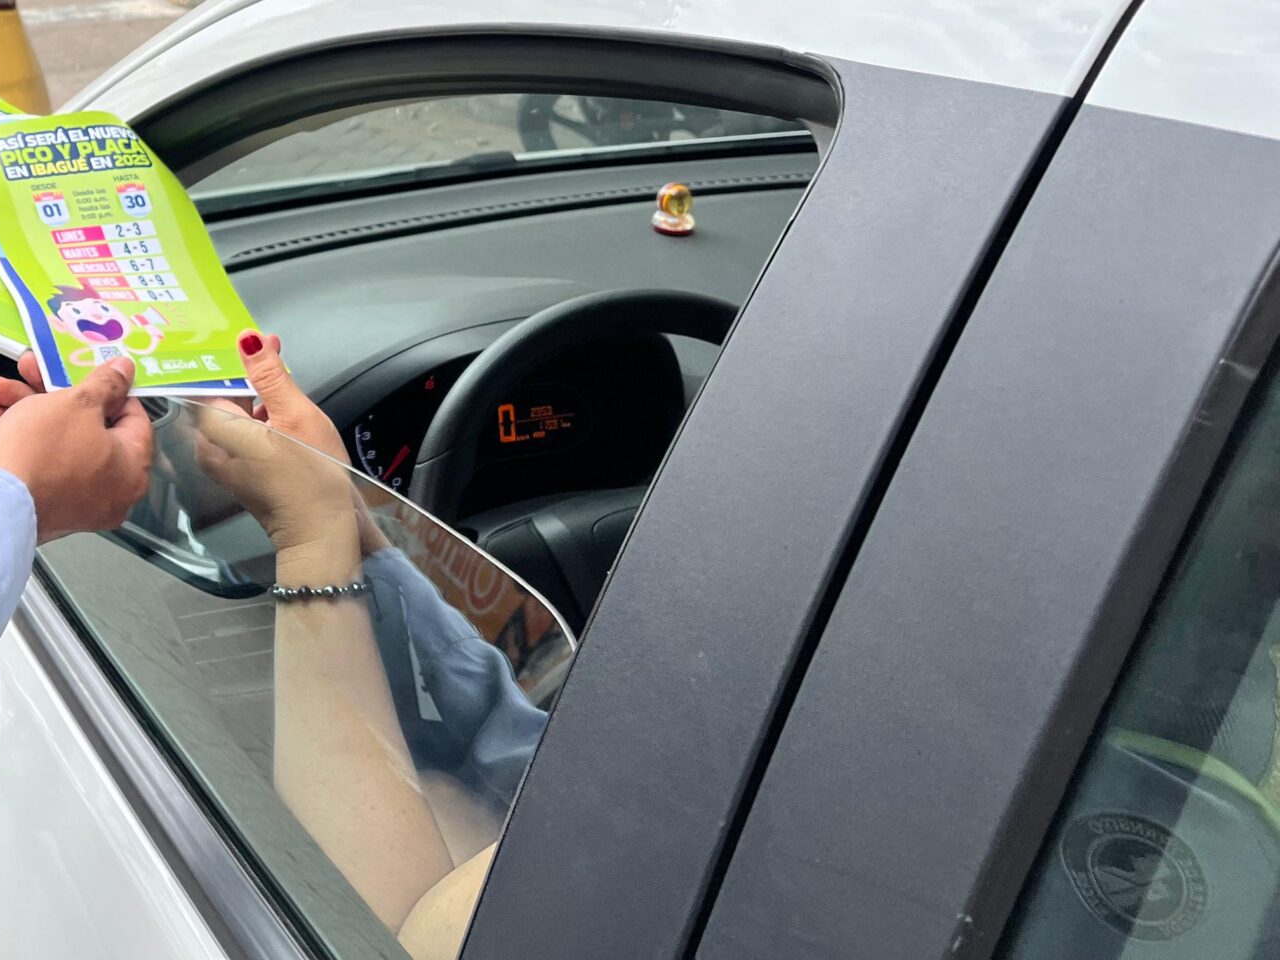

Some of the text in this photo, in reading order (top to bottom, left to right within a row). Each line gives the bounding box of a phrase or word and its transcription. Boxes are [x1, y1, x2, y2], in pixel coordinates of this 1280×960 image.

[24, 128, 69, 147] SERÁ
[67, 128, 89, 142] EL
[87, 126, 137, 139] NUEVO
[1, 138, 145, 167] PICO Y PLACA
[5, 153, 150, 179] EN IBAGUÉ EN 2025
[113, 173, 140, 182] HASTA
[31, 182, 57, 191] DESDE
[124, 195, 146, 209] 30
[42, 203, 62, 217] 01
